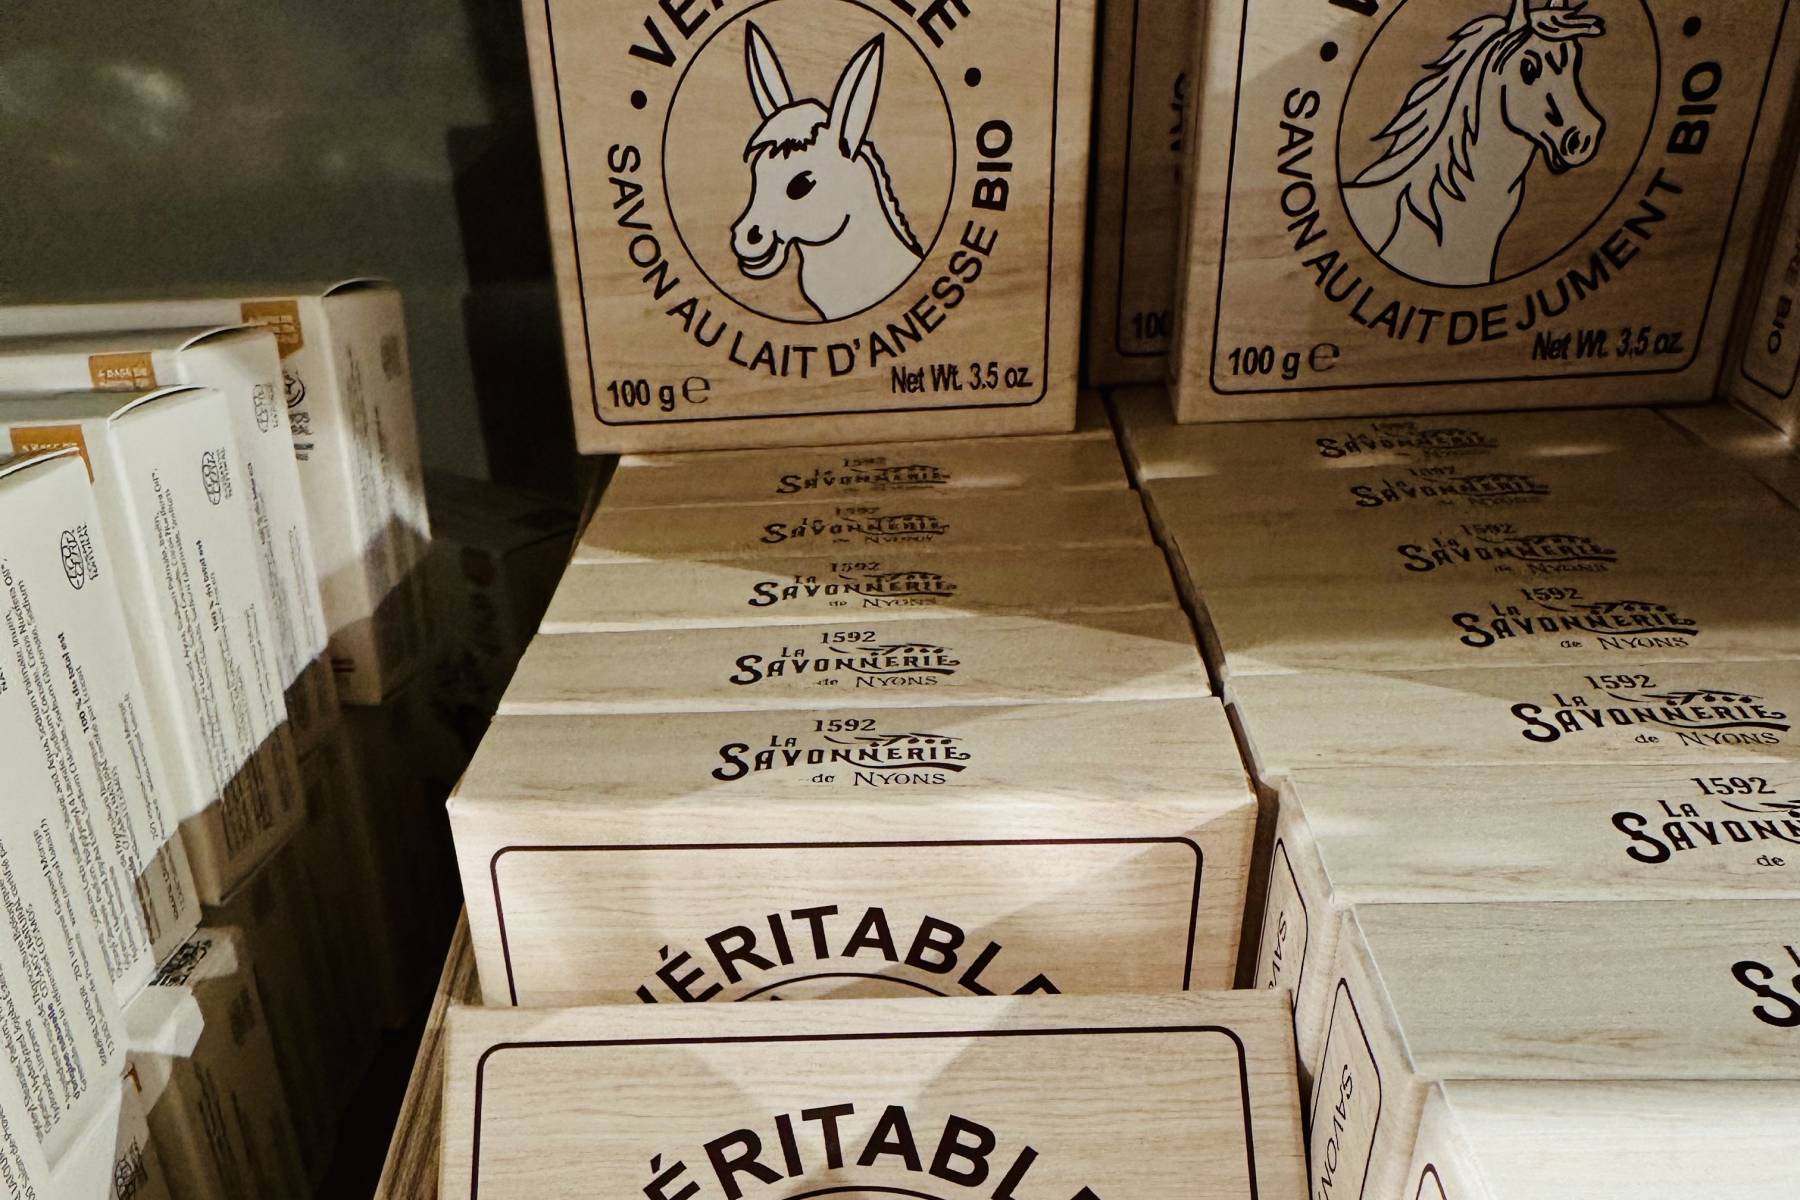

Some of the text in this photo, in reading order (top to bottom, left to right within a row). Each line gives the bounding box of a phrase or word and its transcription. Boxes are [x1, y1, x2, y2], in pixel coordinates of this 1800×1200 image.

[1278, 61, 1722, 345] SAVON AU LAIT DE JUMENT BIO
[607, 143, 681, 299] SAVON
[666, 297, 727, 347] AU
[729, 331, 817, 378] LAIT
[972, 120, 1012, 211] BIO
[1532, 331, 1572, 360] Net
[1616, 326, 1651, 358] 3.5
[1229, 345, 1274, 376] 100
[1282, 353, 1300, 380] g
[891, 366, 925, 393] Net
[969, 362, 998, 390] 3.5
[607, 379, 650, 407] 100
[659, 386, 675, 412] g
[1398, 543, 1616, 571] SAVONNERIE
[748, 580, 957, 607] SAVONNERIE
[1520, 587, 1583, 600] 1592
[821, 632, 876, 644] 1592
[1452, 612, 1698, 648] SAVONNERIE
[1600, 637, 1688, 649] NYONS
[729, 655, 960, 686] SAVONNERIE
[856, 676, 938, 688] NYONS
[1584, 674, 1656, 689] 1592
[814, 720, 876, 732] 1592
[1511, 703, 1791, 742] SAVONNERIE
[1635, 732, 1780, 746] de NYONS
[711, 743, 971, 782] SAVONNERIE
[853, 772, 946, 787] NYONS
[1691, 777, 1776, 795] 1592
[1757, 855, 1785, 866] de
